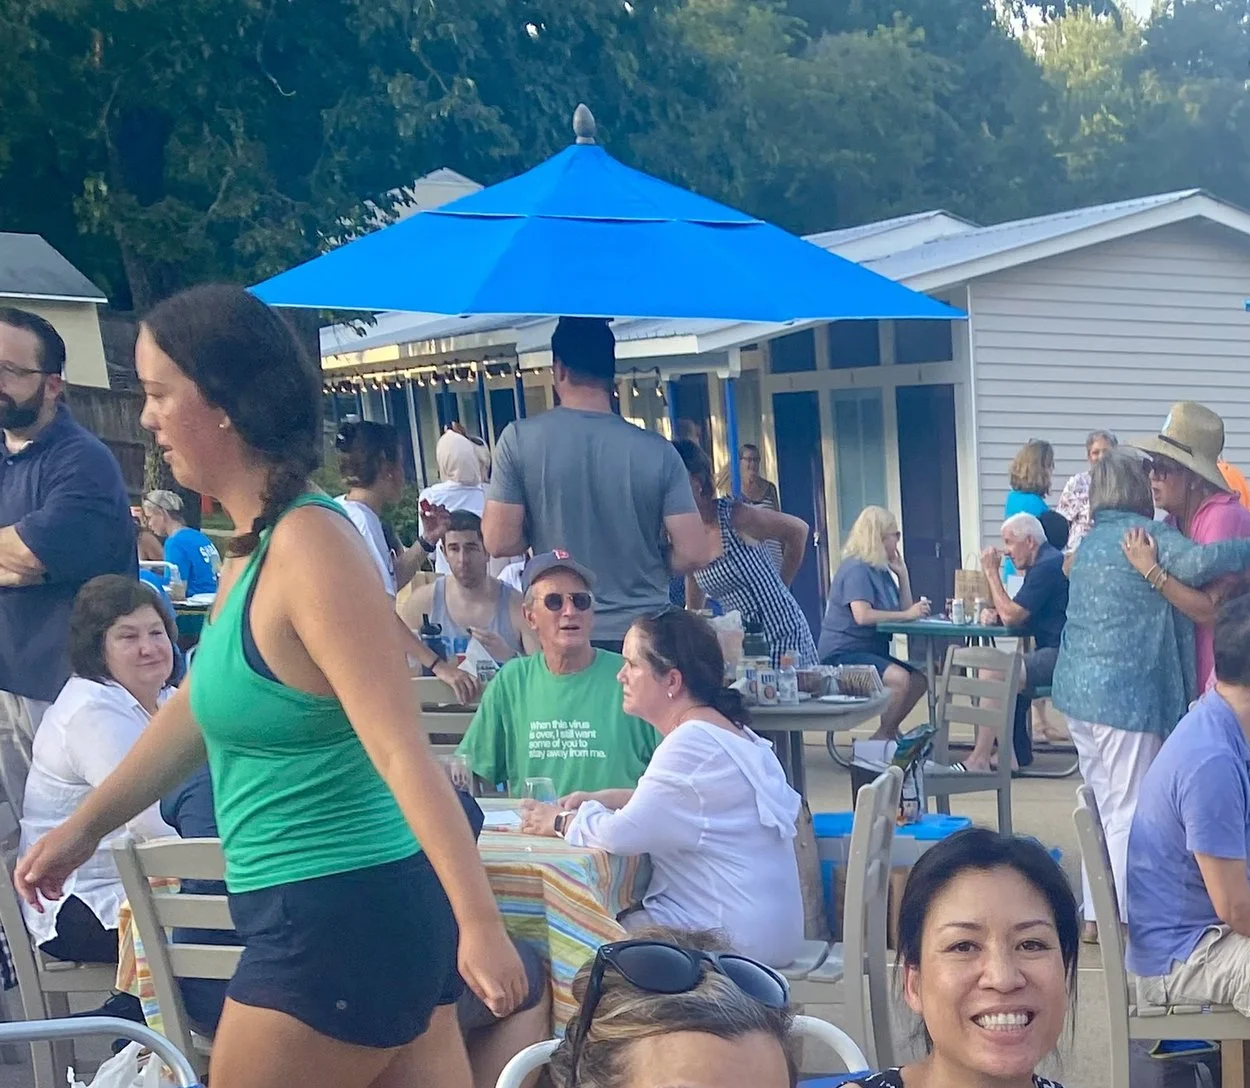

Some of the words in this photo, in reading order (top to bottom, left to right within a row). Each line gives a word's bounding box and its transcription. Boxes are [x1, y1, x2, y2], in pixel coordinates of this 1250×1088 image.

[530, 721, 551, 730] When
[552, 720, 567, 729] this
[569, 720, 590, 729] virus
[529, 731, 535, 739] is
[536, 731, 555, 740] over,
[560, 730, 574, 739] still
[575, 730, 597, 739] want
[528, 740, 551, 749] some
[552, 739, 561, 748] of
[561, 740, 578, 750] you
[579, 739, 588, 748] to
[528, 749, 546, 760] stay
[546, 750, 568, 760] away
[569, 748, 588, 758] from
[590, 750, 607, 758] me.
